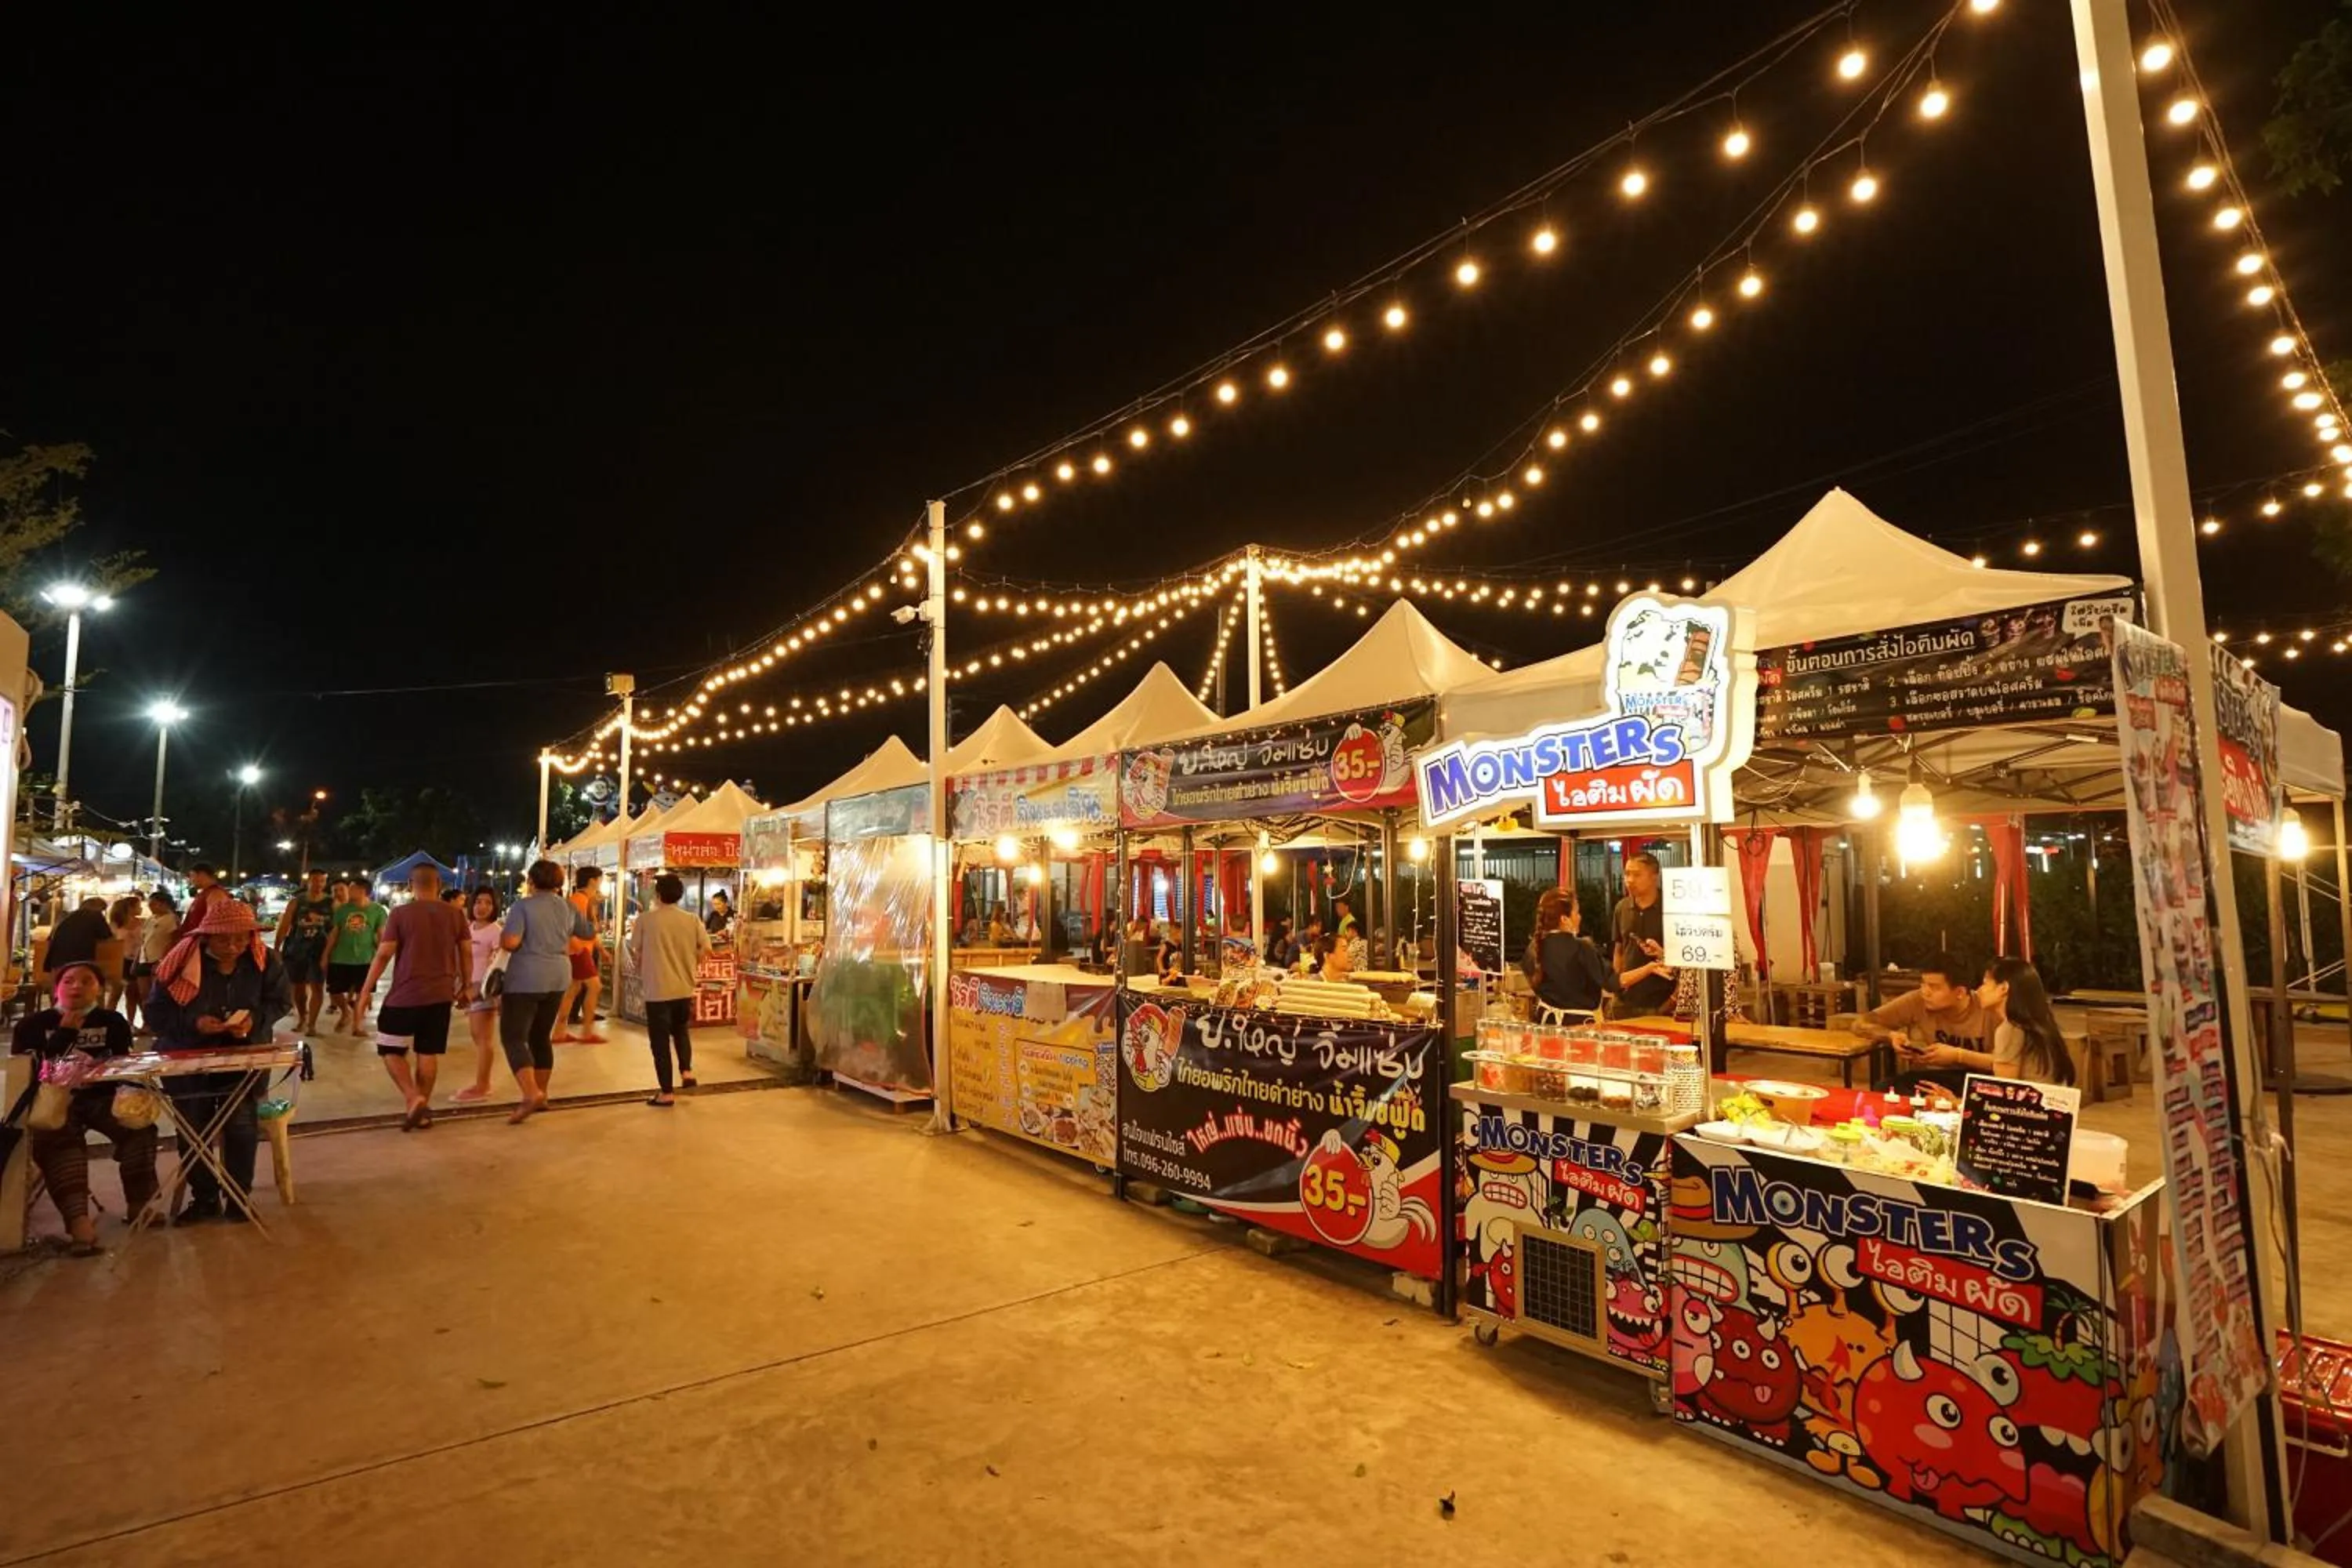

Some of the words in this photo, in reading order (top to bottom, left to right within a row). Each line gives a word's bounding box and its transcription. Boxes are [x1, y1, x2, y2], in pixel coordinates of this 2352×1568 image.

[1786, 628, 1975, 673] ขั้นตอนการสั่งไอติมผัด
[1334, 749, 1381, 782] 35.-
[1426, 717, 1686, 818] MONSTERS
[1553, 768, 1686, 809] ไอติมผัด
[1177, 1055, 1325, 1112] ไก่ยอพริกไทยดำย่าง
[1122, 1141, 1212, 1192] โทร.096-260-9994
[1479, 1116, 1644, 1187] MONSTERS
[1304, 1163, 1367, 1217] 35.-
[1559, 1162, 1641, 1210] ไอติมผัด
[1711, 1166, 2040, 1282] MONSTERS
[1866, 1240, 2032, 1324] ไอติมผัด
